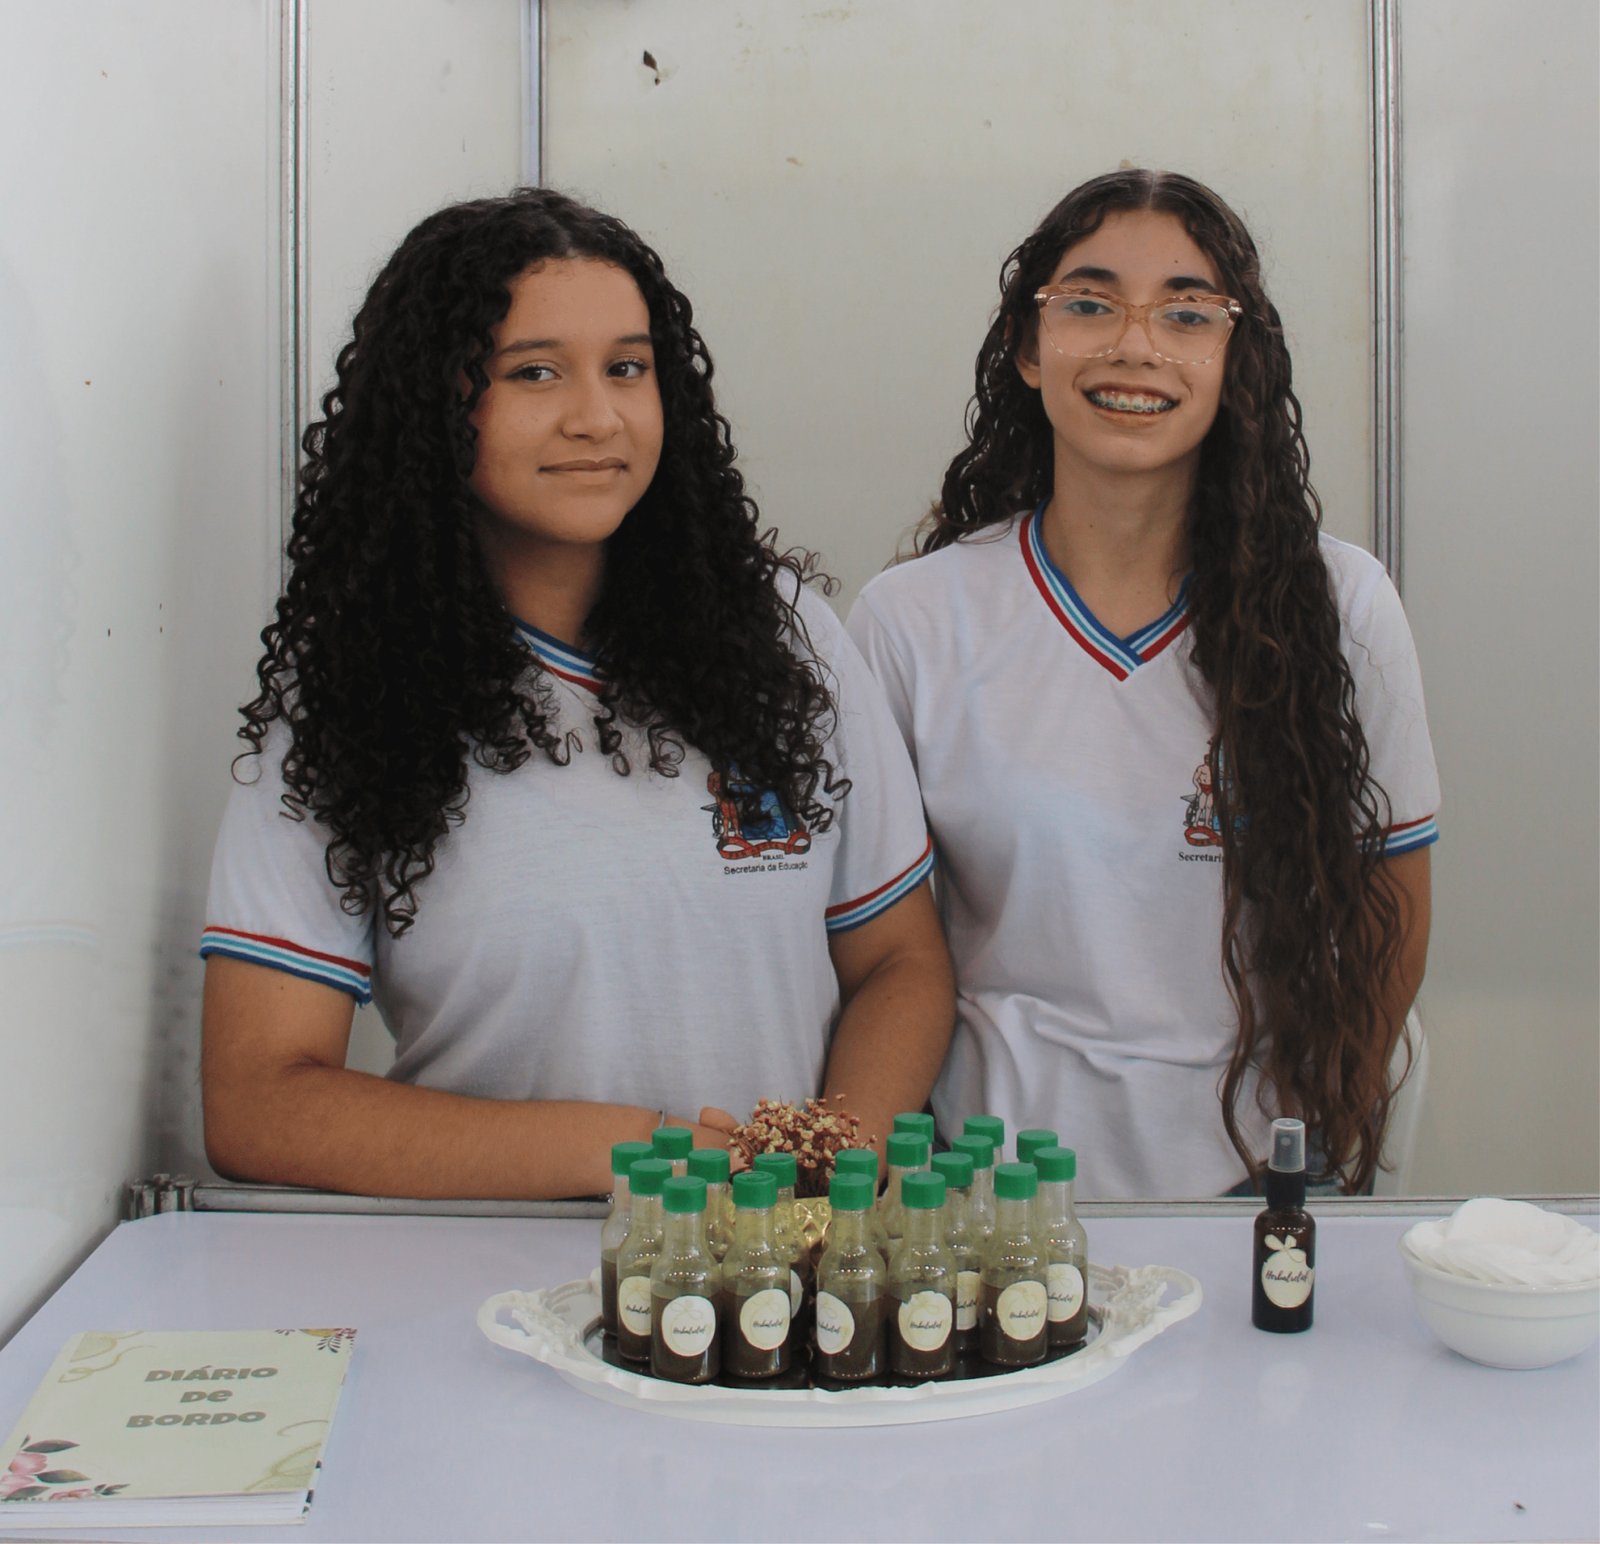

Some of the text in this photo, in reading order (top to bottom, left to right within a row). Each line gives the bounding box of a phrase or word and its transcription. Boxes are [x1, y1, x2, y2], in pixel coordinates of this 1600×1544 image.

[1178, 851, 1224, 863] Secretari
[723, 864, 766, 875] Secretaria
[767, 863, 777, 872] da
[144, 1365, 279, 1382] DIÁRIO
[126, 1411, 267, 1428] BORDO
